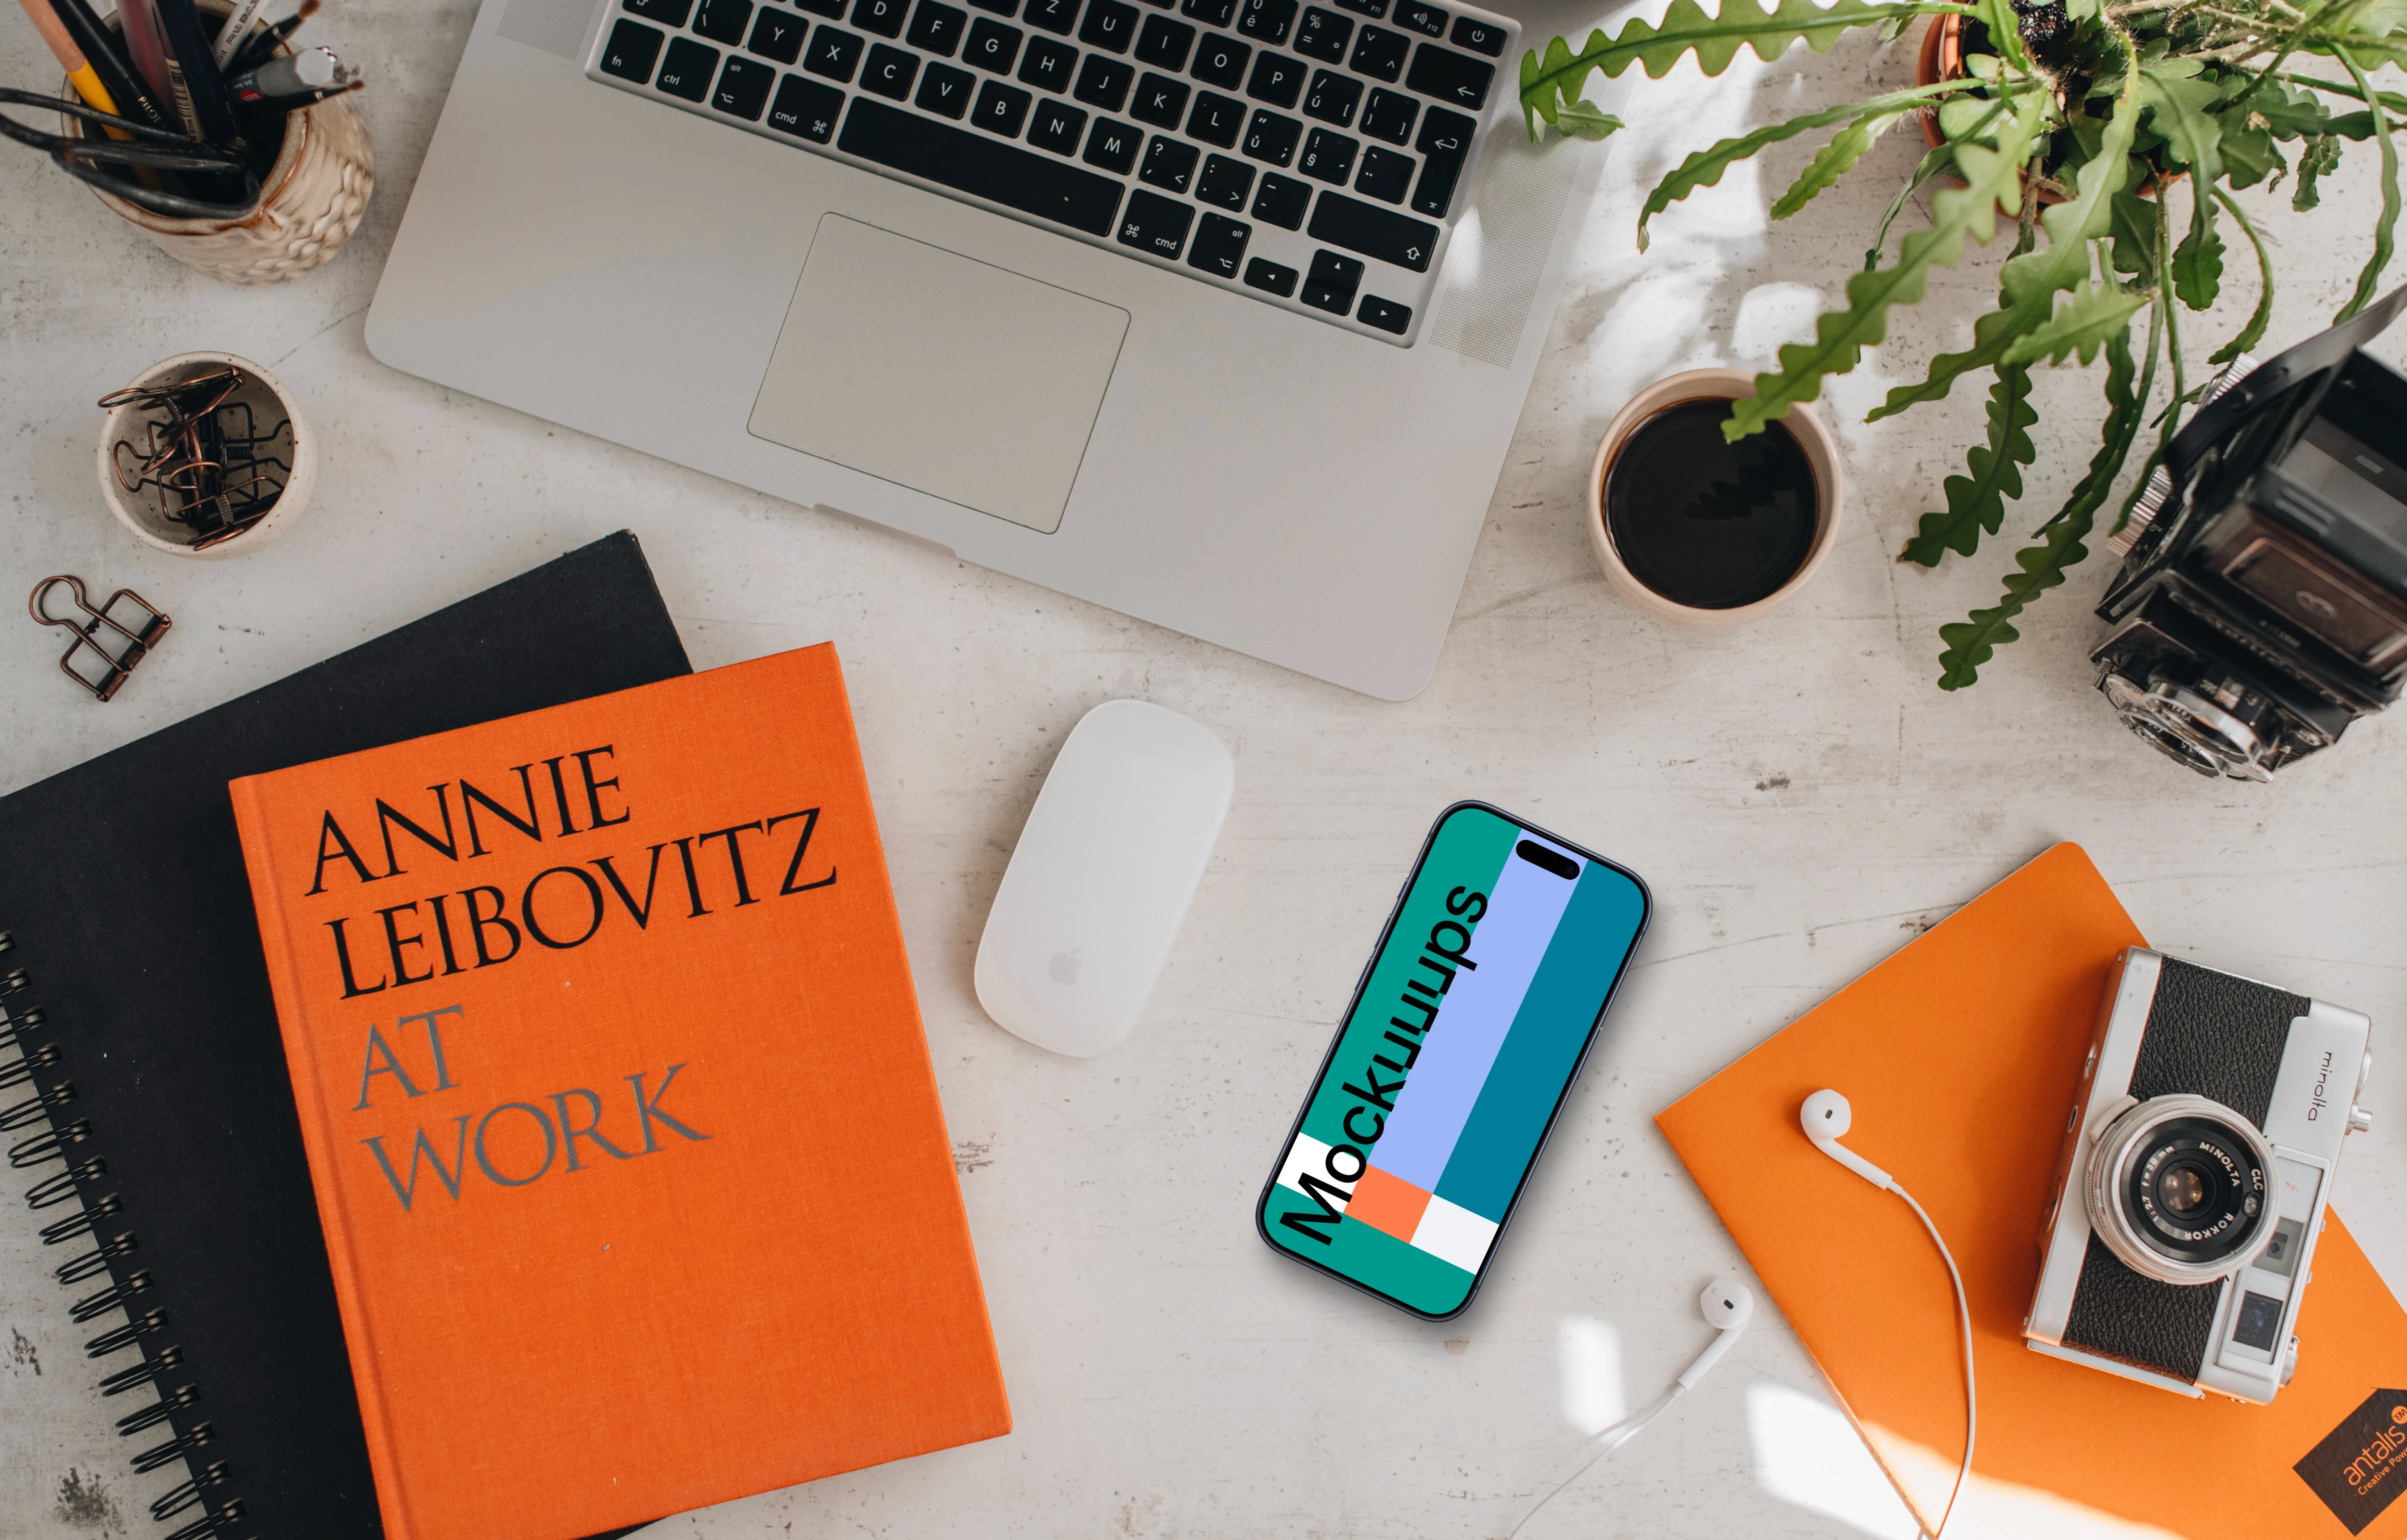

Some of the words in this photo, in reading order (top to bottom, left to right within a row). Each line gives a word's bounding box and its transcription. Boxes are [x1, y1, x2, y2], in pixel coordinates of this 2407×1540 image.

[874, 1, 886, 15] D
[1046, 0, 1059, 13] Z
[932, 20, 942, 33] F
[1103, 17, 1116, 31] U
[1247, 15, 1255, 26] é
[1310, 15, 1320, 28] %
[226, 33, 237, 45] Wood
[774, 27, 784, 41] Y
[986, 39, 998, 52] G
[827, 45, 841, 61] X
[612, 55, 621, 66] fn
[1041, 56, 1055, 71] H
[1215, 54, 1227, 67] O
[731, 64, 741, 73] alt
[884, 65, 896, 78] C
[664, 75, 681, 86] ctrl
[1099, 76, 1109, 89] J
[1272, 72, 1283, 84] P
[942, 82, 952, 96] V
[1154, 93, 1166, 108] K
[138, 96, 162, 123] PILOT
[995, 101, 1006, 115] B
[776, 111, 797, 125] cmd
[1211, 112, 1218, 126] L
[187, 119, 196, 135] MADE
[1050, 119, 1064, 134] N
[1104, 137, 1120, 153] M
[1155, 143, 1163, 155] ?
[1232, 230, 1243, 238] alt
[1156, 238, 1177, 250] cmd
[304, 744, 631, 897] ANNIE
[324, 807, 837, 1000] LEIBOVITZ
[351, 1004, 464, 1111] AT
[1279, 886, 1488, 1246] Mockuuups
[2307, 1052, 2332, 1121] minolta
[360, 1062, 714, 1213] WORK
[2199, 1142, 2241, 1187] MINOLTA
[2252, 1168, 2263, 1191] CLC
[2184, 1213, 2235, 1240] ROKKOR
[2343, 1425, 2406, 1486] antalis
[2358, 1466, 2391, 1495] Creative
